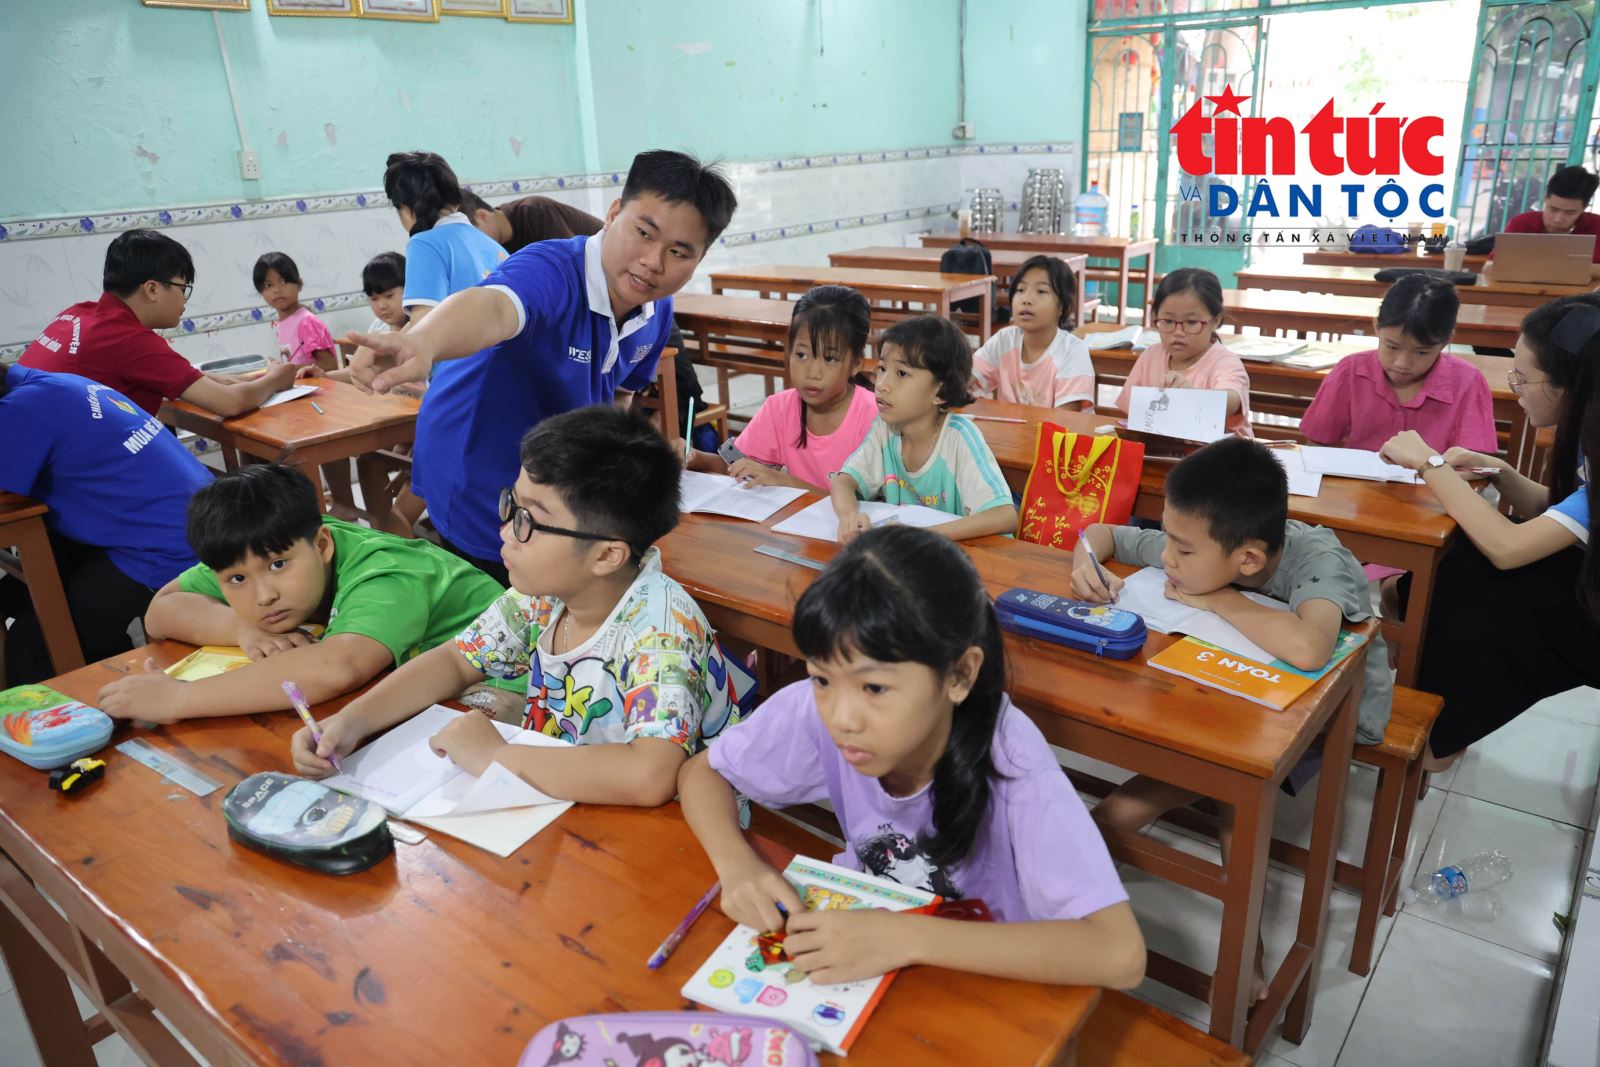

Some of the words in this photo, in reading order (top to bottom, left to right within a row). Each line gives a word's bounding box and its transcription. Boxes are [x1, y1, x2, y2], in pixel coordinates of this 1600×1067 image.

[122, 427, 153, 455] MÙA
[1196, 650, 1216, 662] 3
[1218, 657, 1281, 683] TOÁN
[241, 778, 275, 808] SPACE
[877, 821, 894, 833] MX
